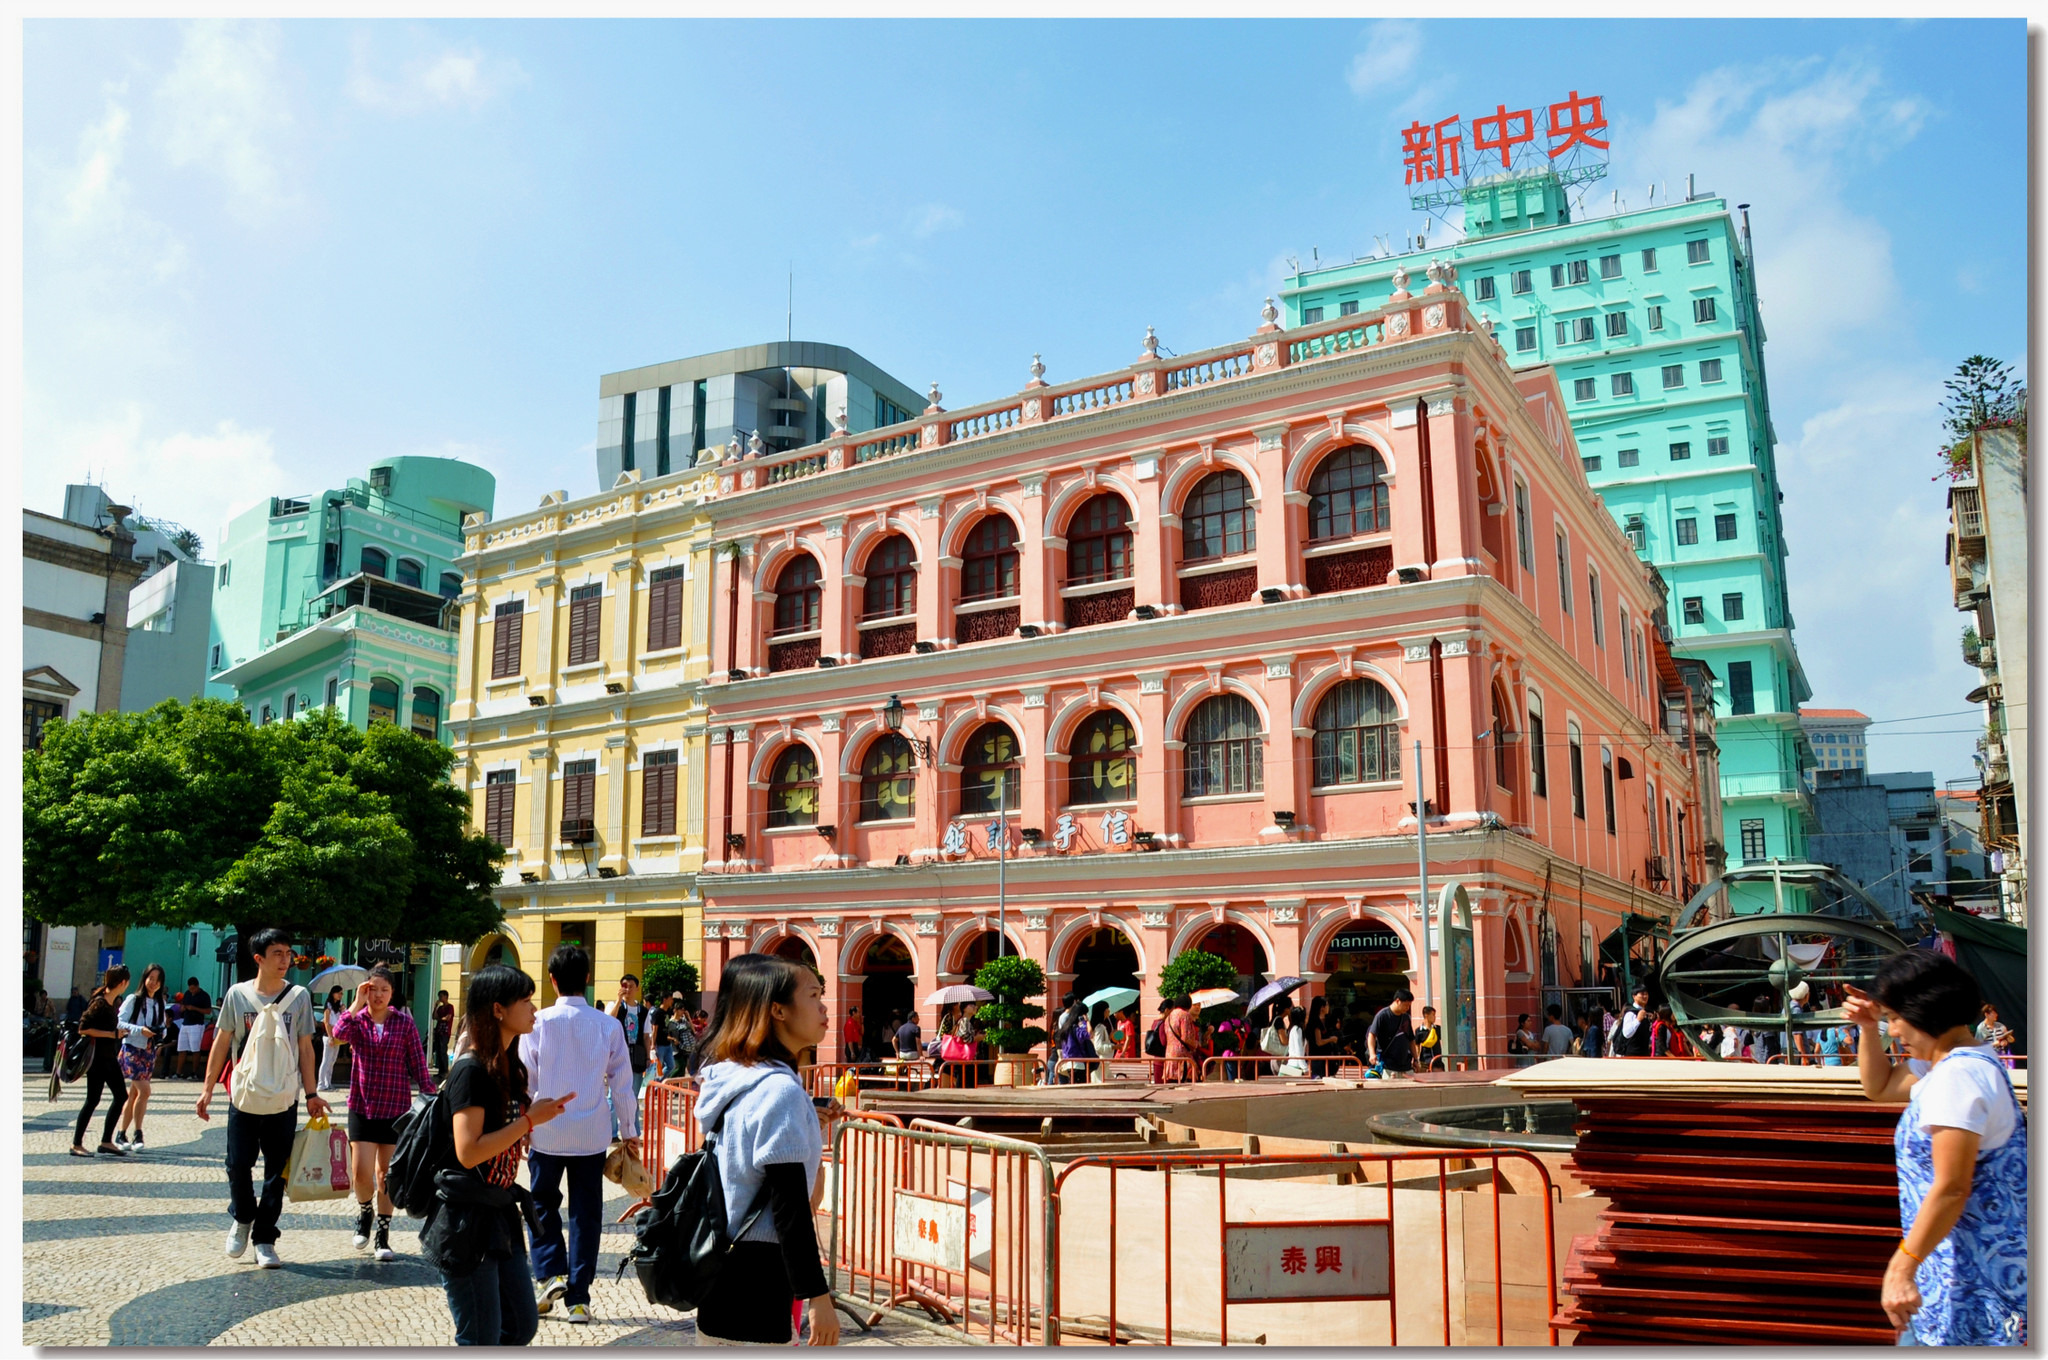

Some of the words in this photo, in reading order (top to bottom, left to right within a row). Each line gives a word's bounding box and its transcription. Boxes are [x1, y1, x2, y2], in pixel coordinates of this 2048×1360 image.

[1401, 90, 1610, 185] 新中央
[1331, 933, 1403, 949] manning
[1280, 1246, 1343, 1275] 泰興
